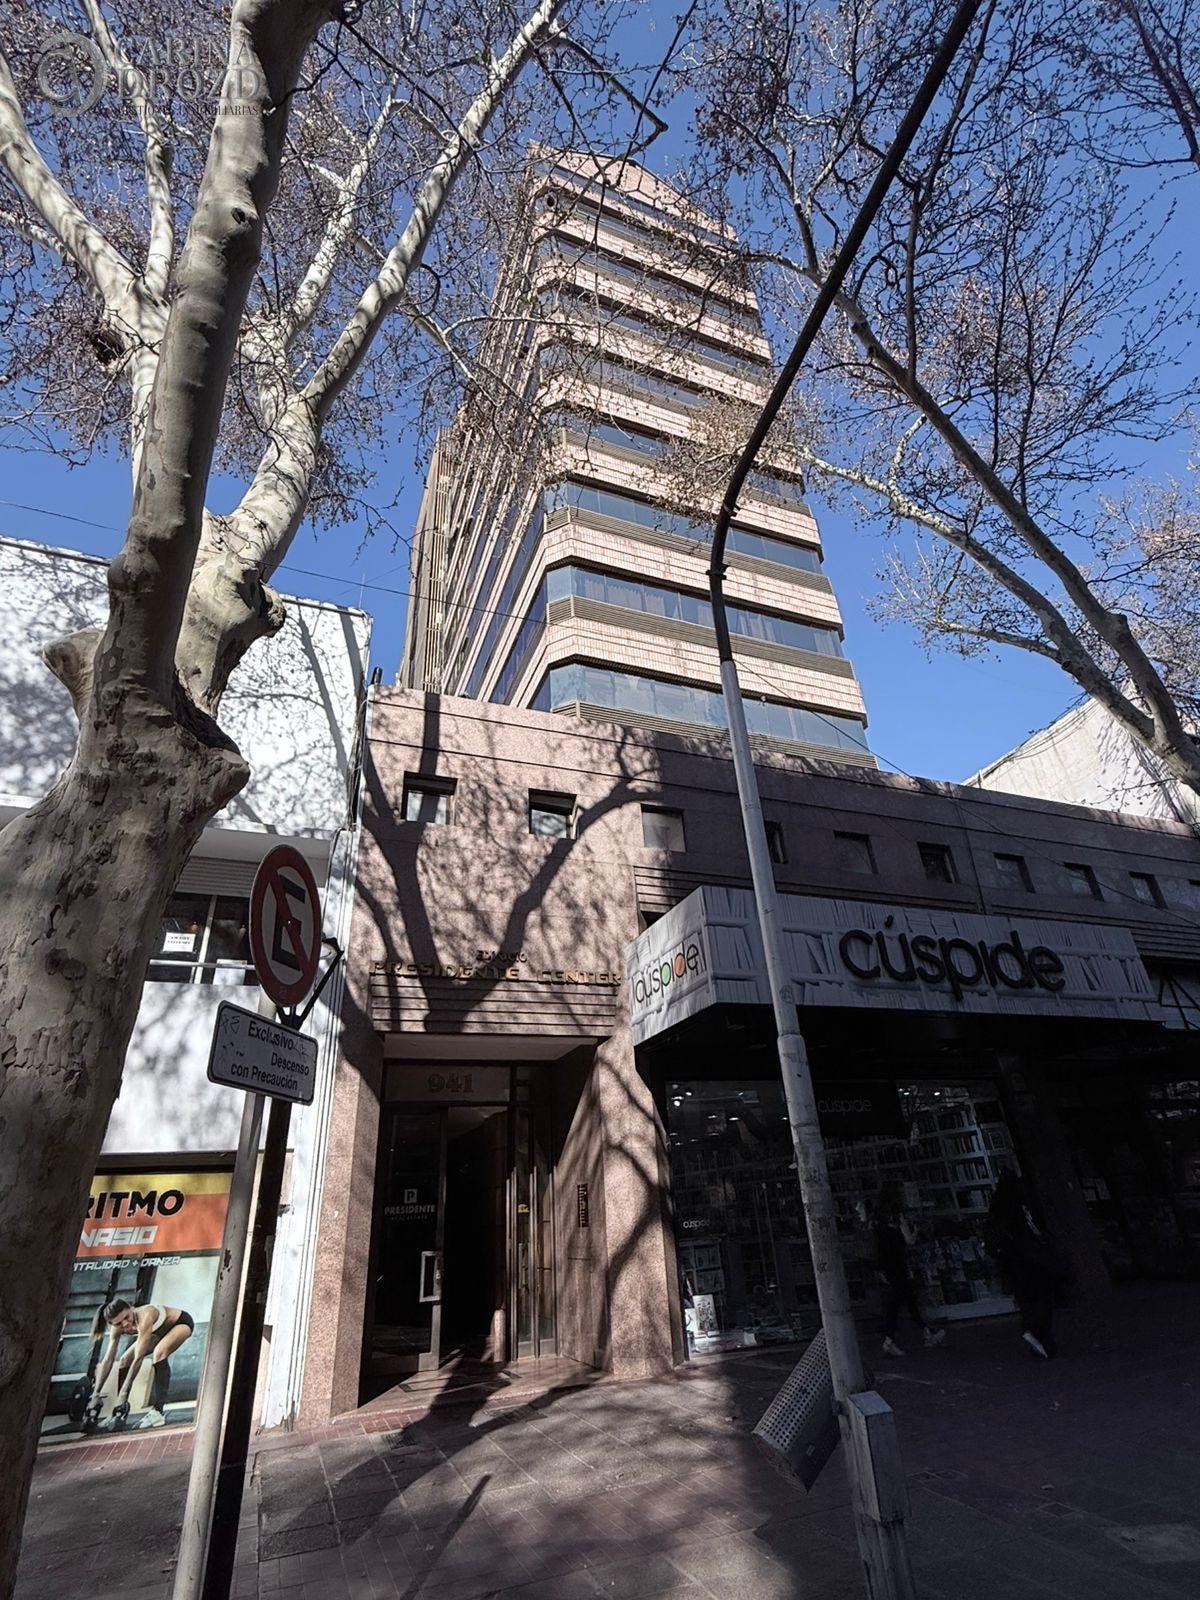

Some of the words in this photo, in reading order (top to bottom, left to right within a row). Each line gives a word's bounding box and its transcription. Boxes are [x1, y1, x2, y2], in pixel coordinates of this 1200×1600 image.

[839, 914, 1066, 1001] cúspide
[368, 960, 520, 982] PRESIDENTE
[537, 970, 622, 987] CENTER
[247, 1020, 294, 1050] Exclusivo
[230, 1063, 249, 1078] con
[250, 1065, 298, 1090] Precaución
[271, 1052, 309, 1076] Descenso
[425, 1072, 475, 1093] 941
[384, 1204, 436, 1215] PRESIDENTE
[72, 1258, 130, 1272] ITALIDAD
[140, 1256, 182, 1268] DANZA
